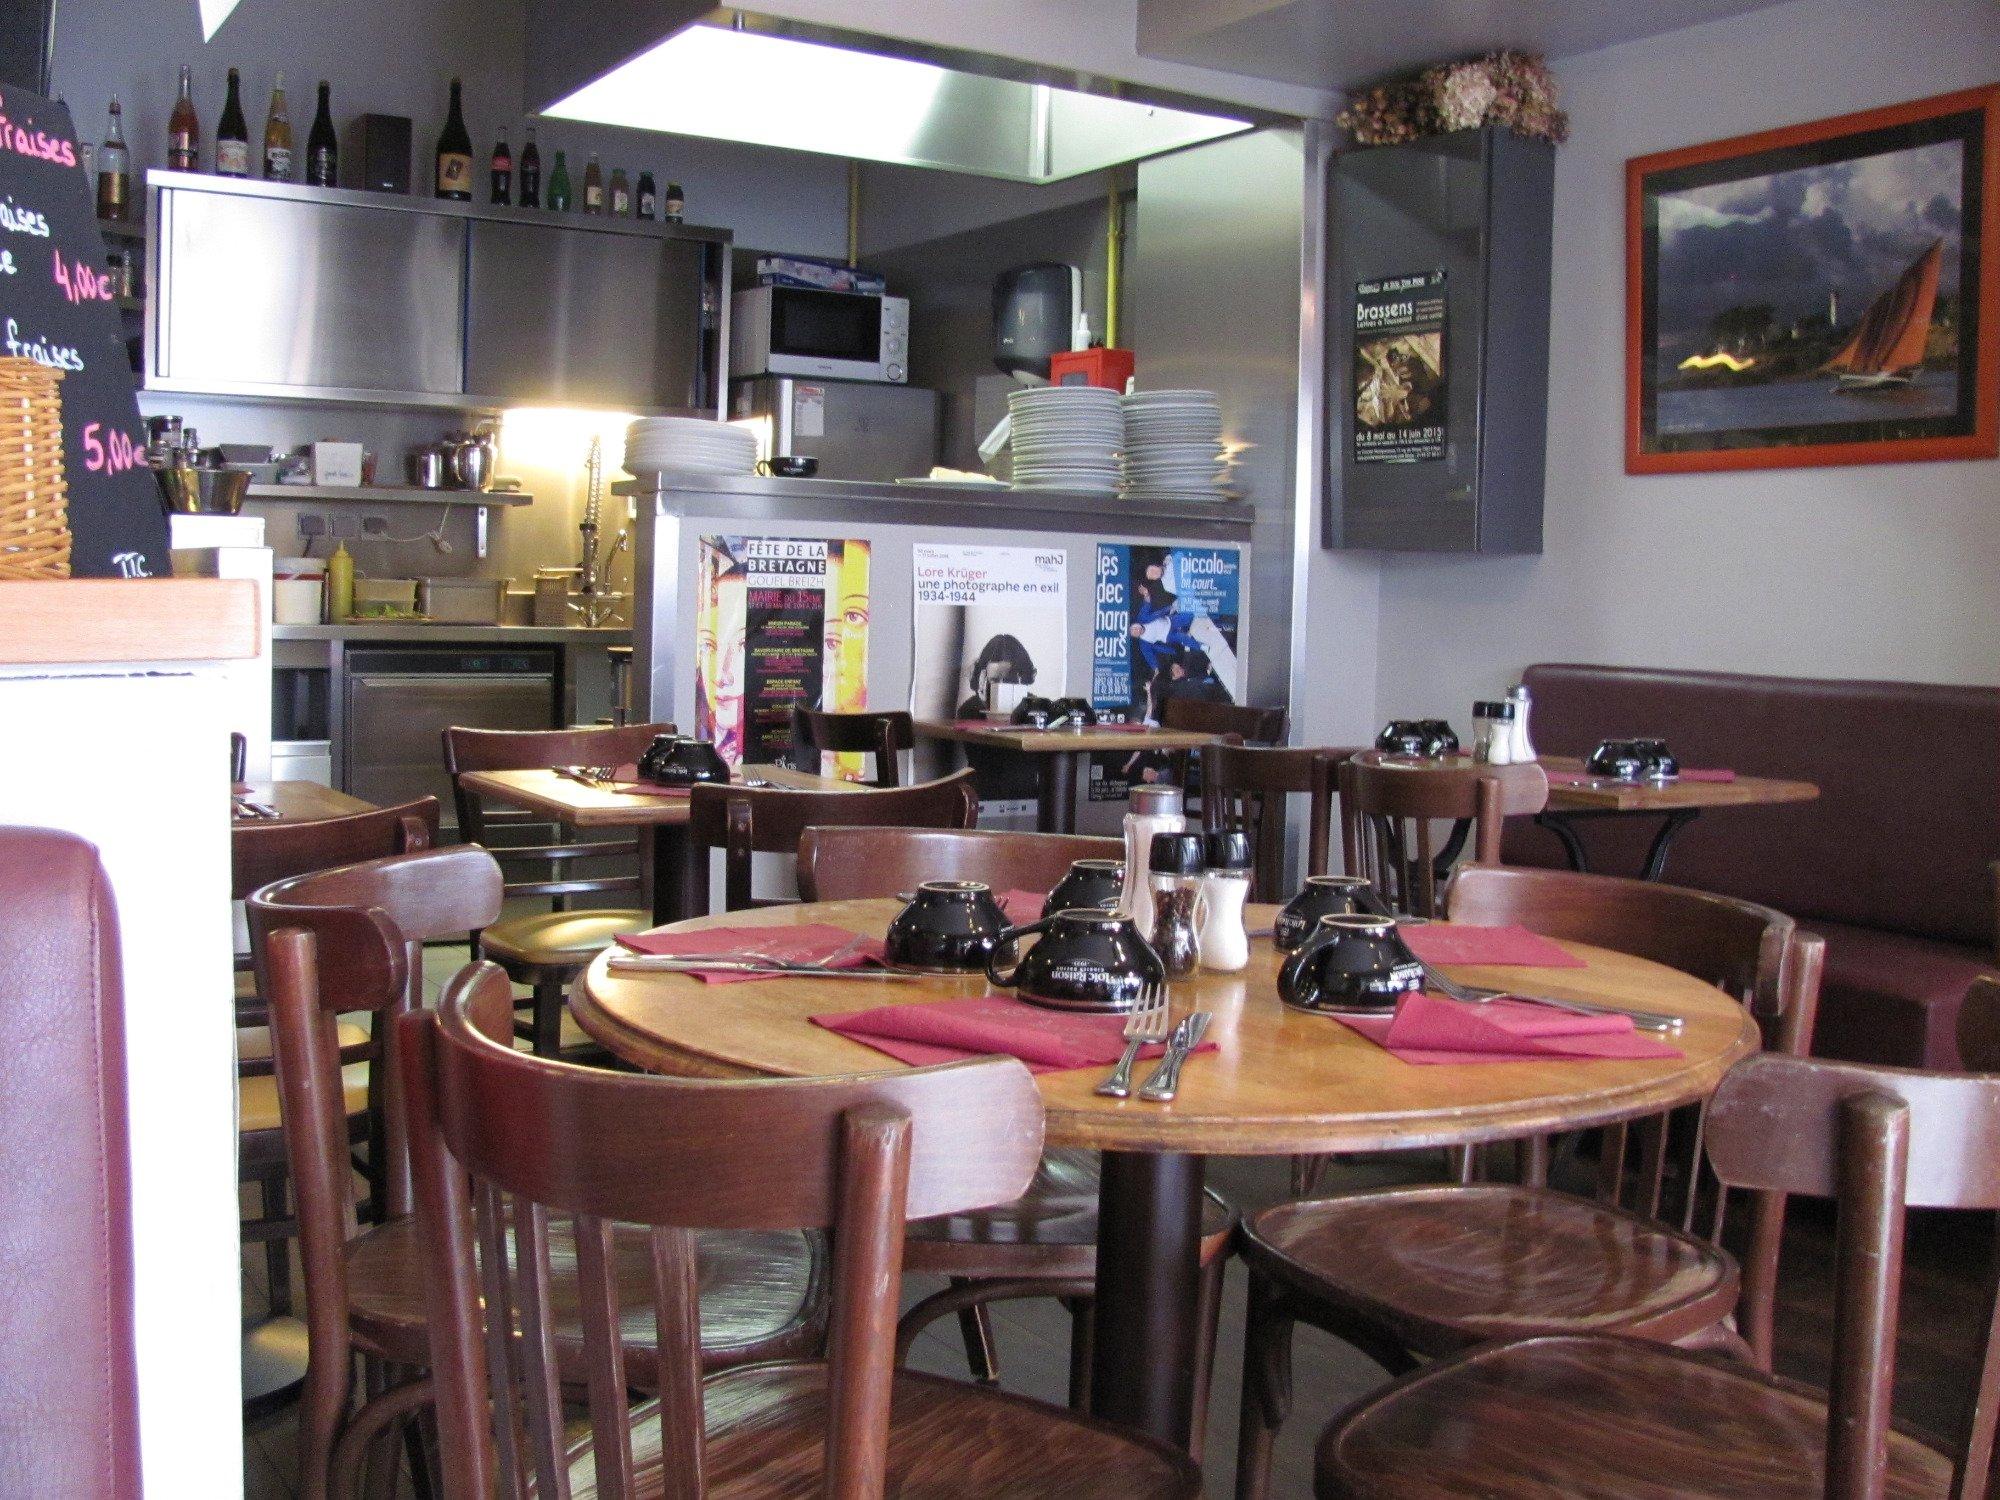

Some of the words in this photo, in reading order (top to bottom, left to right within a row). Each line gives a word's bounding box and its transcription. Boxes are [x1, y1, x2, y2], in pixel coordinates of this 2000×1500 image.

[1357, 301, 1413, 321] Brassens
[6, 317, 85, 371] fraises
[749, 540, 780, 556] FÊTE
[786, 544, 803, 557] DE
[809, 545, 825, 557] LA
[748, 559, 826, 574] BRETAGNE
[1097, 546, 1119, 576] les
[1181, 552, 1224, 578] piccolo
[788, 576, 824, 588] BREIZH
[917, 567, 944, 578] Lore
[947, 567, 988, 581] Krüger
[918, 580, 940, 590] une
[944, 580, 1020, 593] photographe
[1023, 582, 1038, 591] en
[1040, 582, 1059, 593] exil
[919, 590, 976, 602] 1934-1944
[1097, 575, 1123, 603] dec
[1096, 601, 1128, 638] harg
[1095, 637, 1127, 657] eurs
